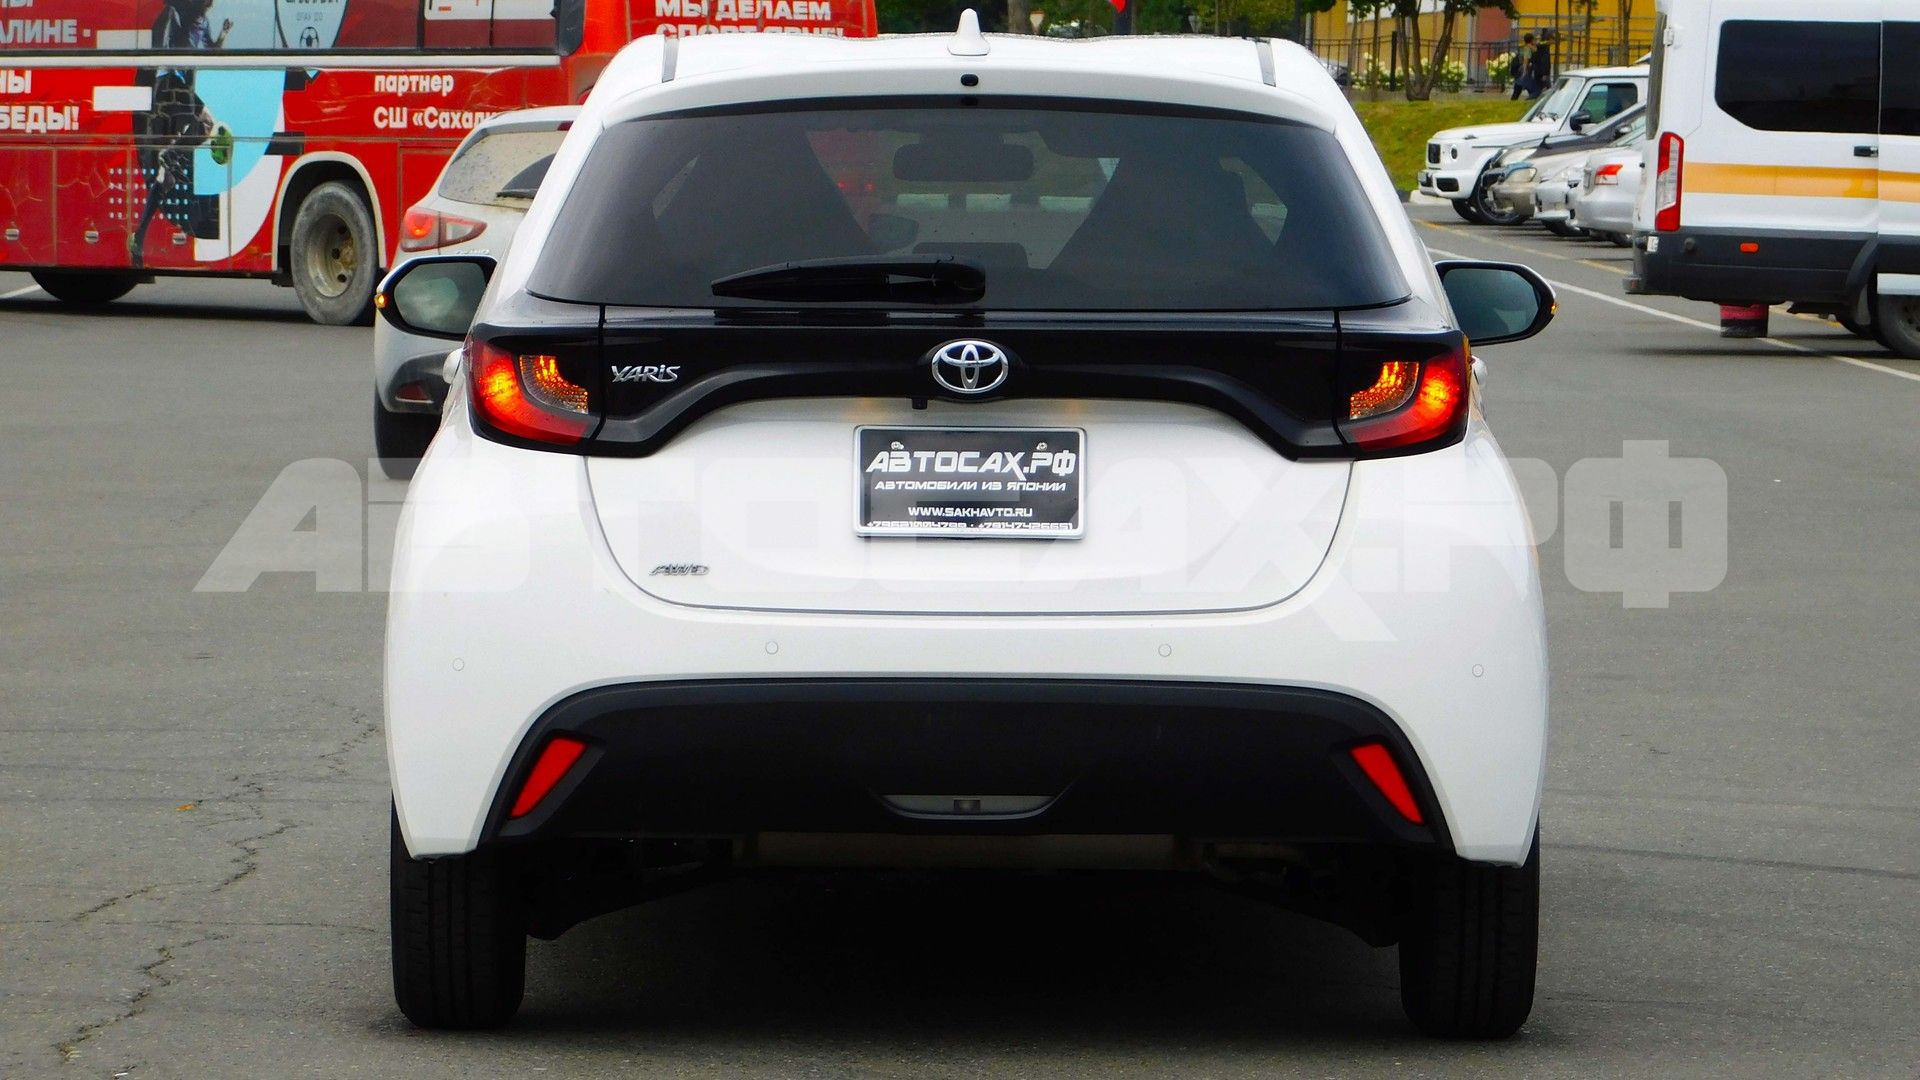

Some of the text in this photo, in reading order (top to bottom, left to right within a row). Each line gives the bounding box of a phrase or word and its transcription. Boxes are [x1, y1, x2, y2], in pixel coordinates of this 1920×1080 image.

[655, 0, 832, 21] МЫ ДЕЛАЕМ
[374, 74, 454, 97] партнер
[373, 106, 408, 129] СШ
[866, 450, 1077, 481] АВТОСАХ.РФ
[875, 480, 1067, 492] АВТОМОБИЛИ ИЗ ЯПОНИИ
[908, 506, 1033, 518] WWW.SAKHAVTO.RU
[650, 563, 709, 576] AWD
